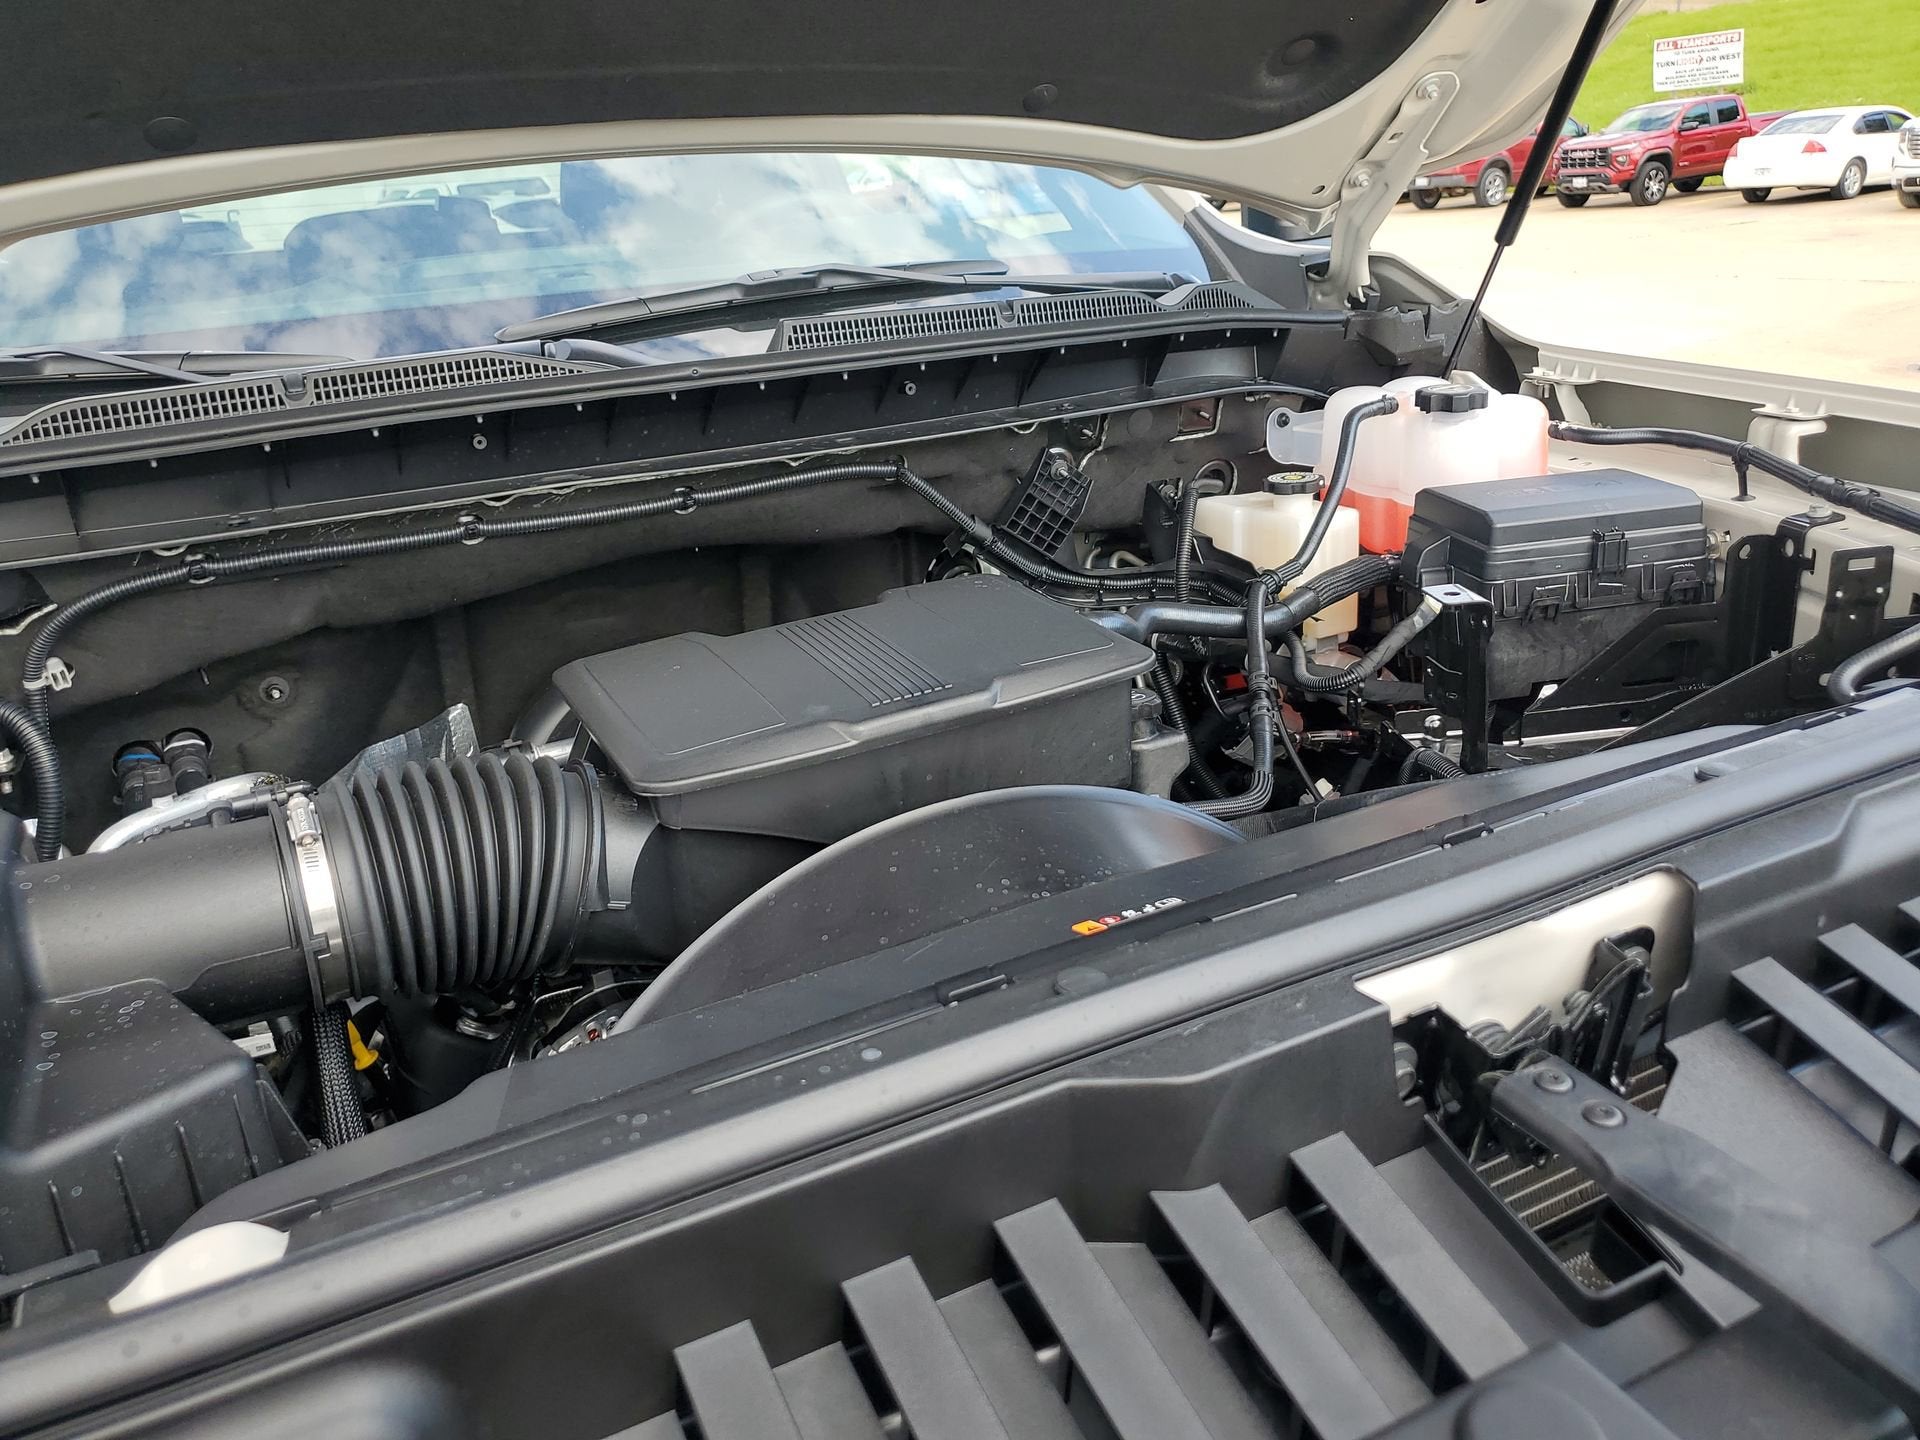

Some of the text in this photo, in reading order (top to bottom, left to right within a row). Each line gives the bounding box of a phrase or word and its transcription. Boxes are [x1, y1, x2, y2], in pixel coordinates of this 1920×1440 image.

[1658, 32, 1739, 50] ALL TRANSPORTS
[1656, 60, 1675, 68] TURN
[1719, 52, 1741, 60] WEST
